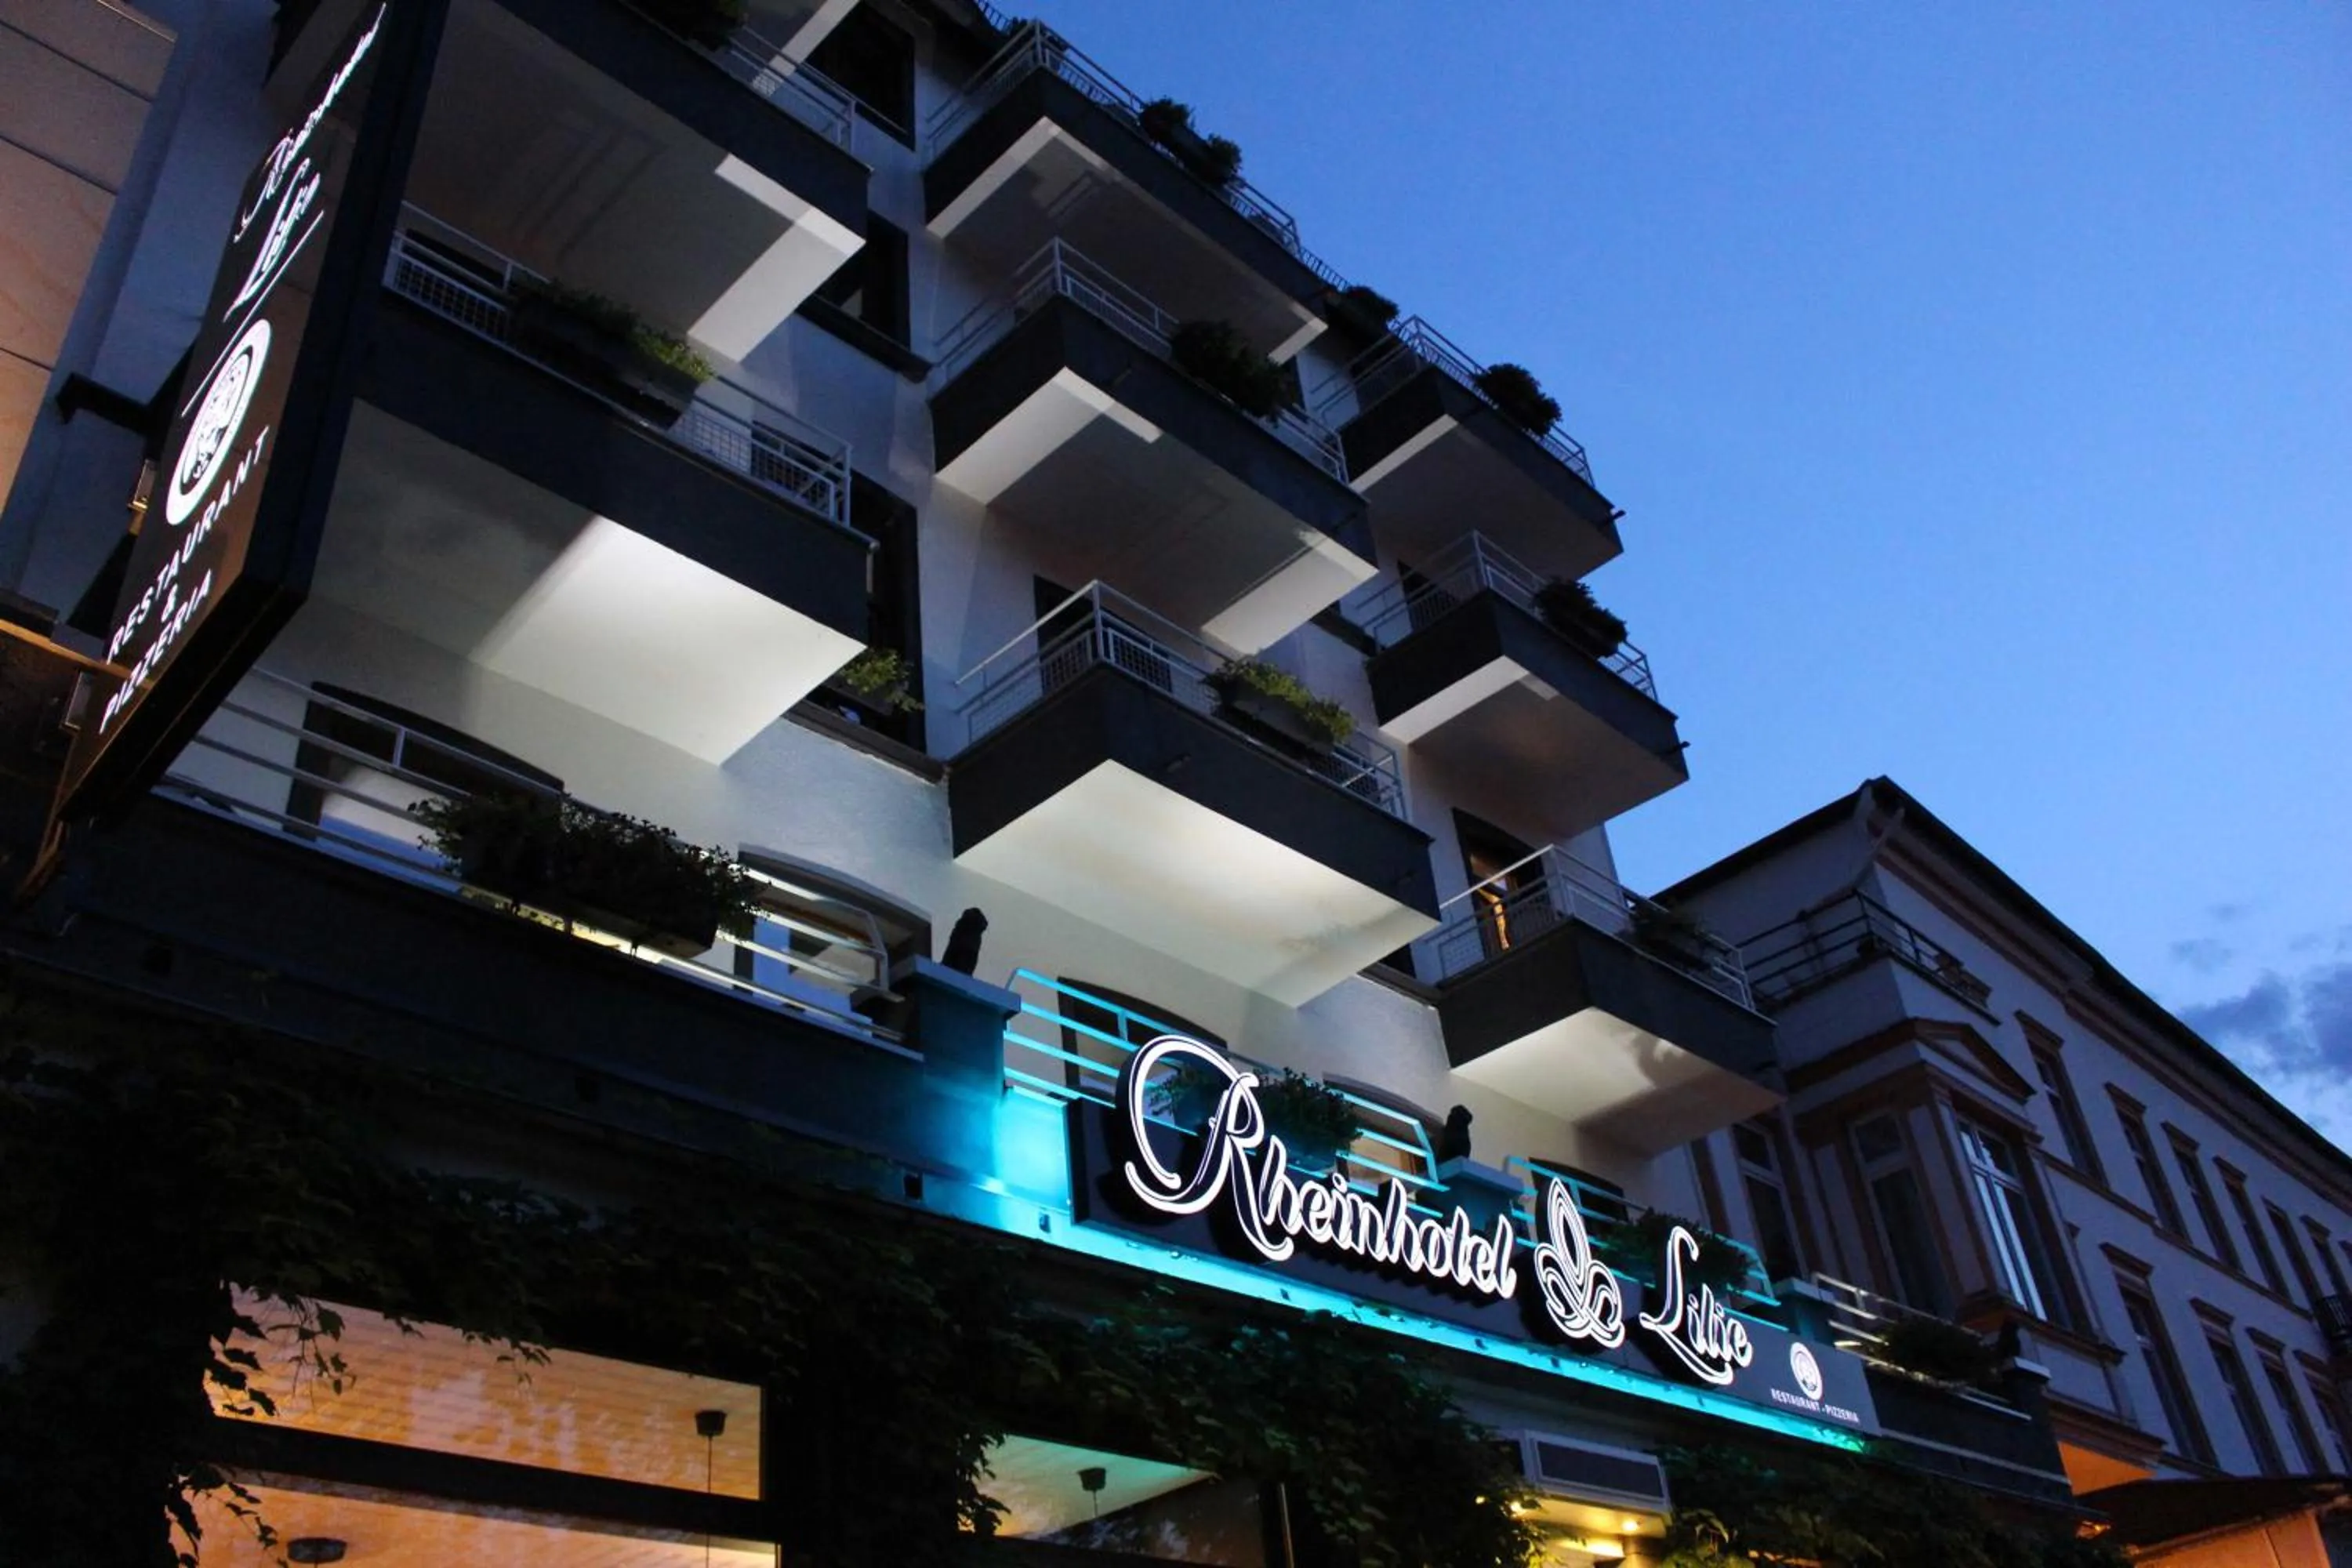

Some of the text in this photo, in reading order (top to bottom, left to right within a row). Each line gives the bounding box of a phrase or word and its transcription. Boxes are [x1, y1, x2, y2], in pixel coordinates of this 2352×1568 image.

[107, 426, 270, 665] RESTAURANT
[161, 583, 178, 623] &
[99, 568, 212, 735] PIZZERIA
[1125, 1034, 1753, 1385] Rheinhotel Lilie
